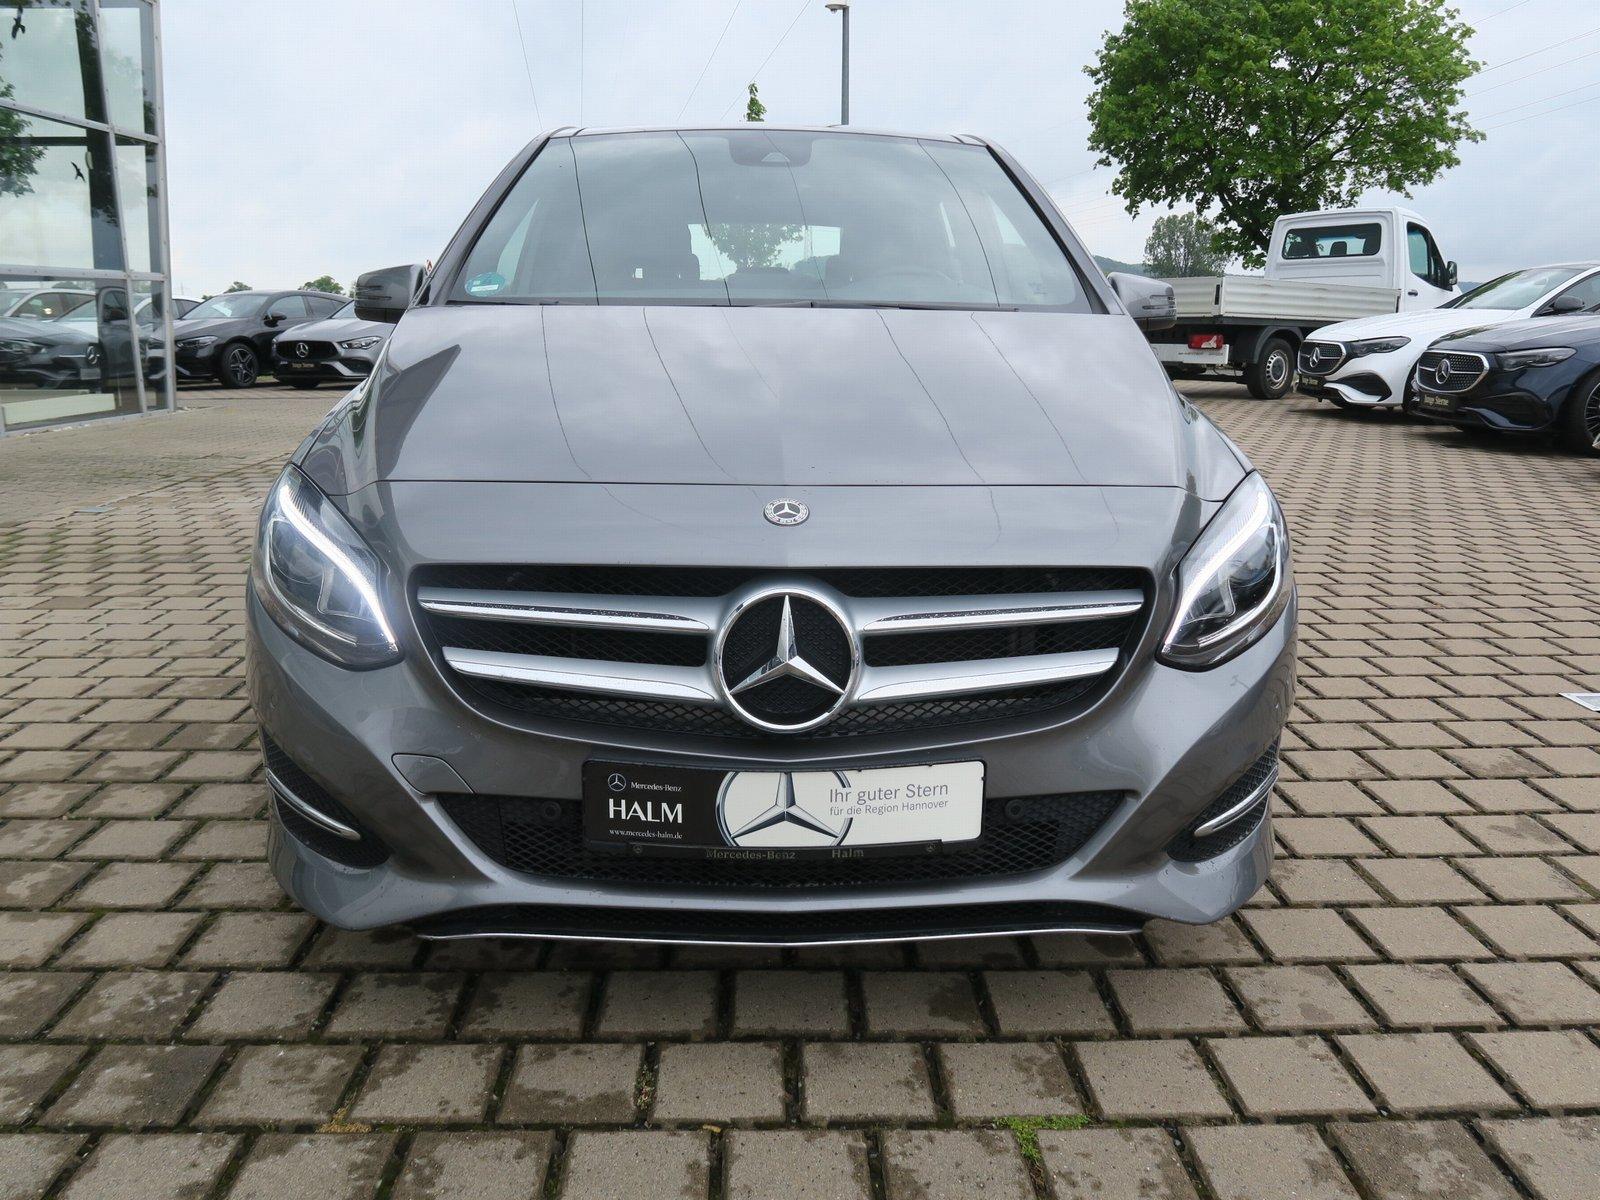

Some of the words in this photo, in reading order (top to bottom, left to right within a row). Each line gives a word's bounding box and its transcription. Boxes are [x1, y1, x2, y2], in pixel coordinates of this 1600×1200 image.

[630, 781, 682, 793] Mercedes-Benz
[829, 788, 851, 803] Ihr
[856, 787, 901, 806] guter
[905, 783, 949, 799] Stern
[608, 798, 683, 824] HALM
[829, 806, 844, 816] für
[846, 805, 862, 815] die
[865, 804, 899, 816] Region
[901, 800, 949, 811] Hannover
[609, 829, 683, 840] www.mercedes-halm.de
[705, 848, 798, 860] Mercedes-Benz
[831, 847, 865, 859] Halm
